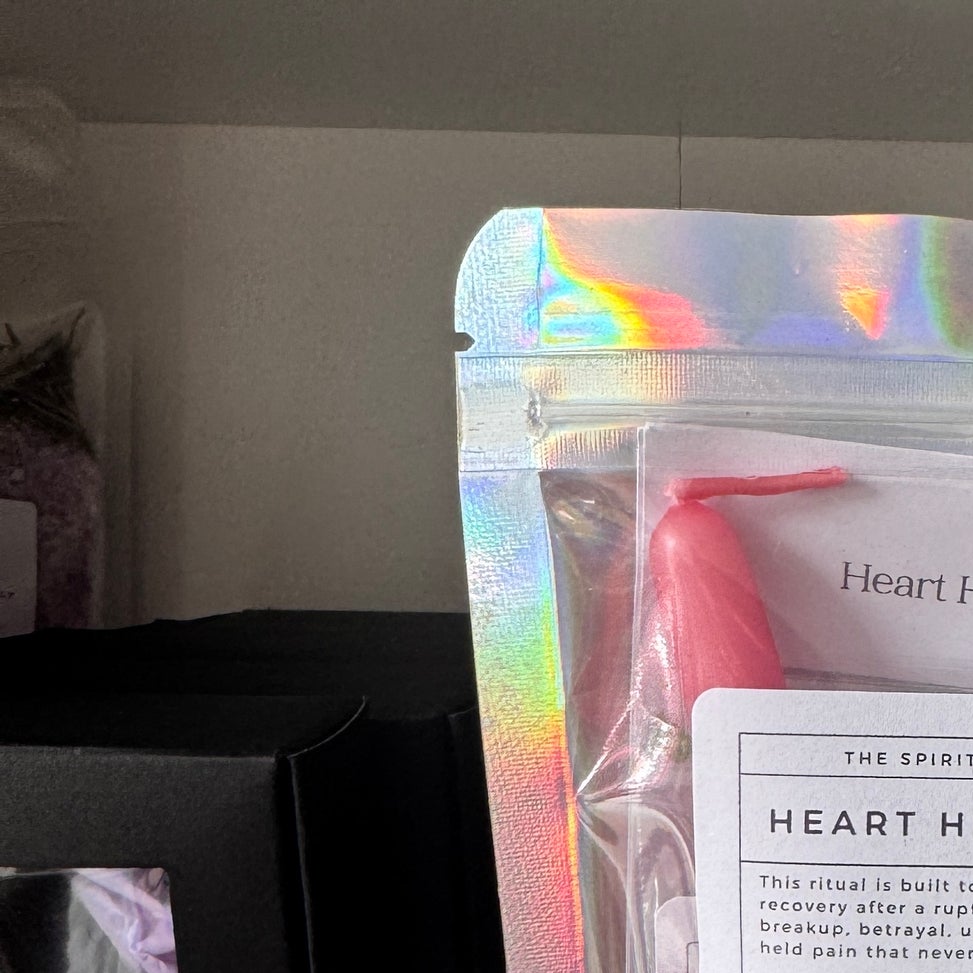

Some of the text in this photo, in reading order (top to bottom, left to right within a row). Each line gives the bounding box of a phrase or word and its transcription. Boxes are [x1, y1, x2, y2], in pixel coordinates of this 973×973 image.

[840, 561, 947, 602] Heart
[844, 751, 888, 765] THE
[770, 808, 916, 837] HEART
[759, 875, 801, 889] This
[809, 877, 866, 892] ritual
[876, 878, 891, 892] is
[901, 878, 950, 893] built
[759, 900, 848, 917] recovery
[856, 900, 906, 915] after
[914, 903, 925, 915] a
[760, 919, 851, 939] breakup,
[760, 941, 802, 956] held
[813, 943, 857, 960] pain
[866, 945, 909, 959] that
